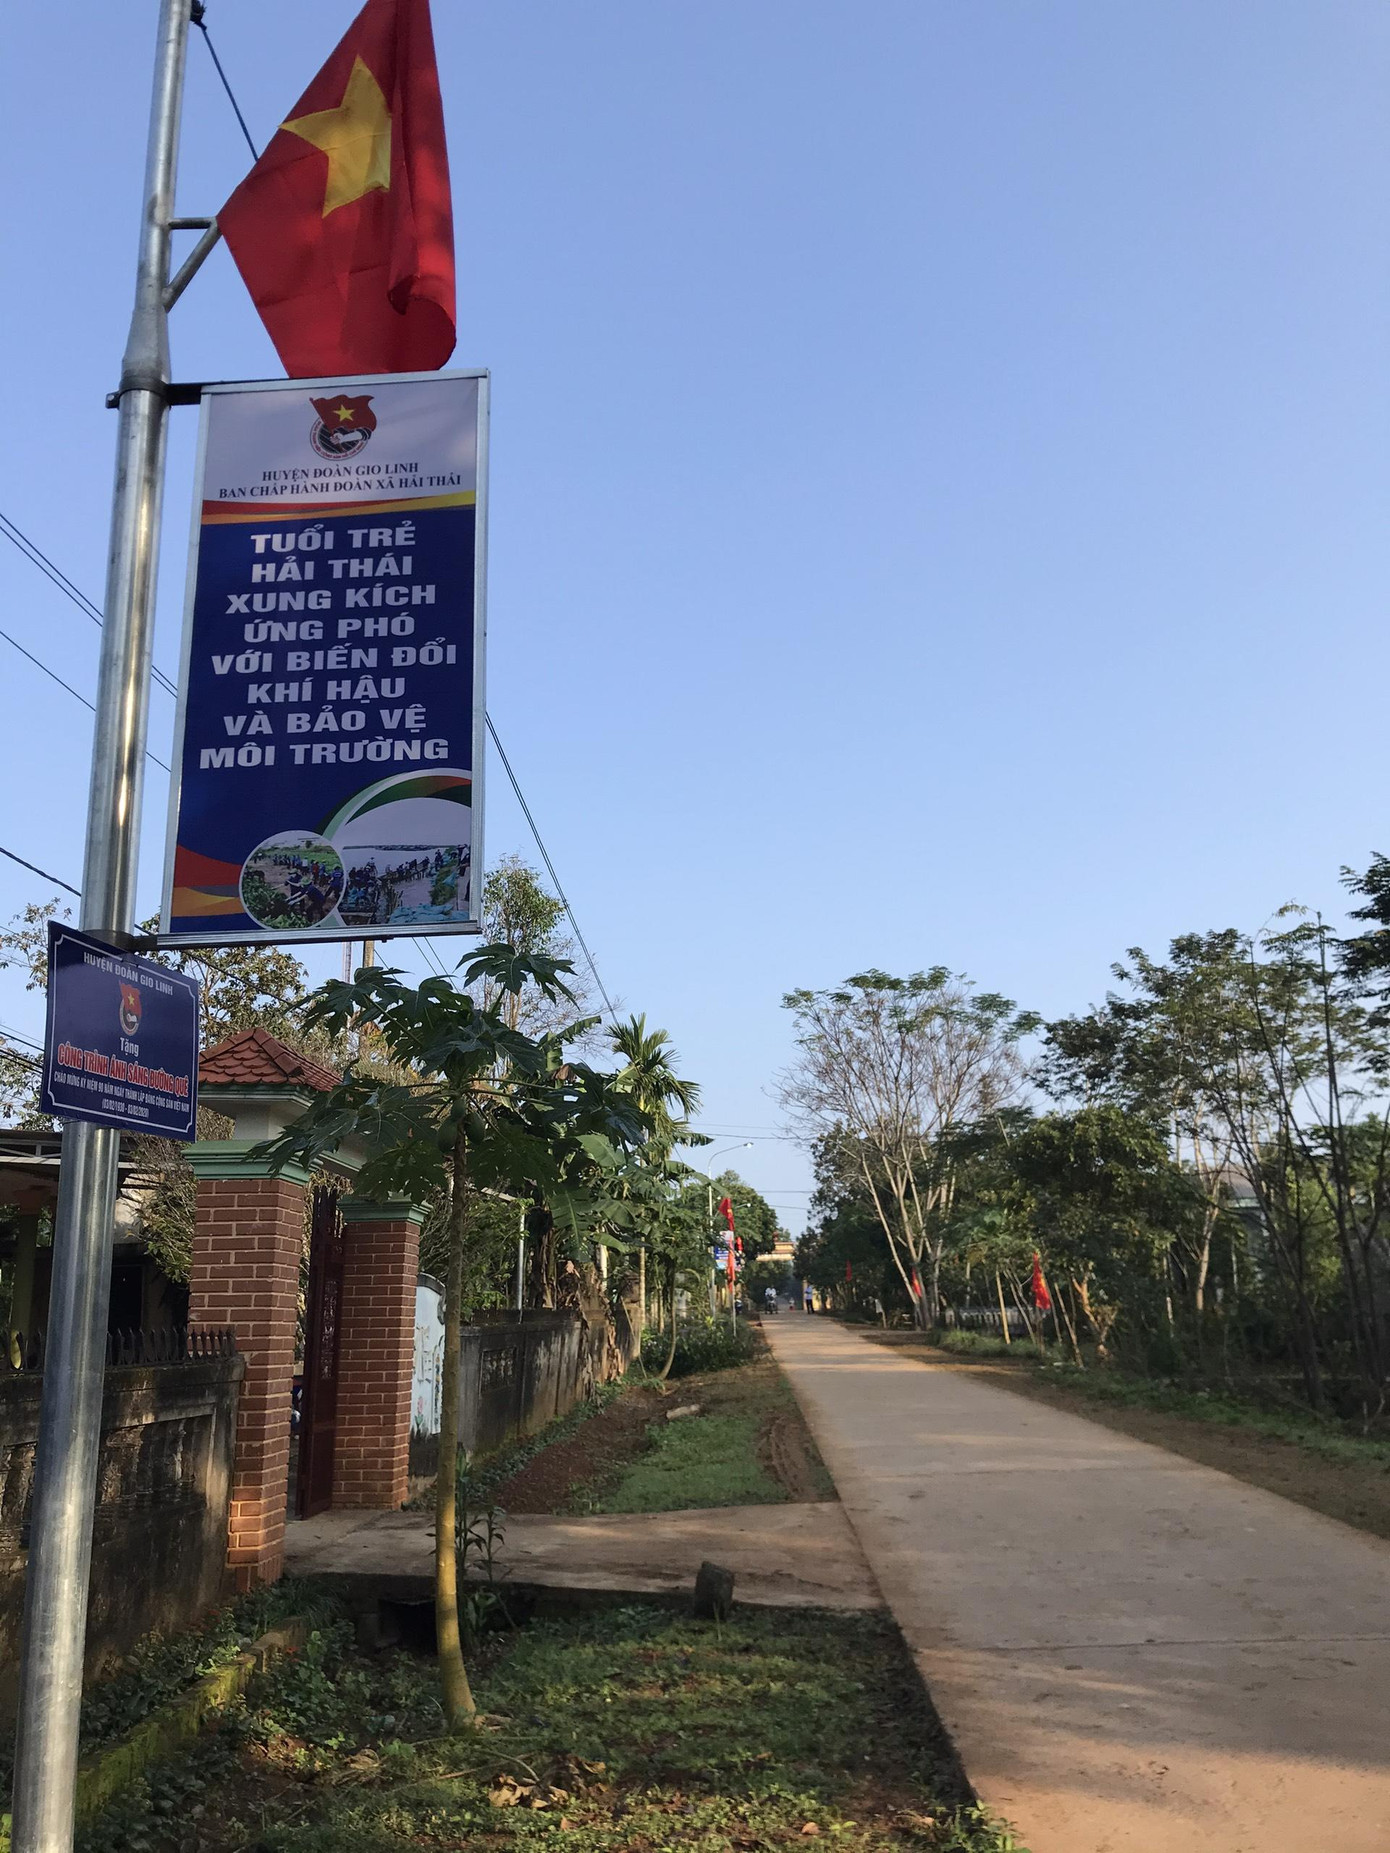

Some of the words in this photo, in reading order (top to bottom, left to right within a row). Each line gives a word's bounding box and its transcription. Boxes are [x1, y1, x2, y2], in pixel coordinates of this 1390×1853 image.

[219, 487, 248, 498] BAN
[290, 481, 330, 494] HÀNH
[333, 477, 372, 492] ĐOÀN
[375, 475, 395, 490] XÃ
[398, 474, 424, 488] HẢI
[427, 471, 461, 486] THÁI
[262, 467, 310, 482] HUYỆN
[313, 464, 352, 478] ĐOÀN
[355, 464, 382, 476] GIO
[385, 462, 419, 474] LINH
[250, 523, 335, 553] TUỔI
[347, 520, 416, 549] TRẺ
[251, 555, 315, 583] HẢI
[328, 552, 412, 579] THÁI
[225, 589, 332, 615] XUNG
[345, 583, 436, 609] KÍCH
[243, 618, 324, 643] ỨNG
[337, 612, 415, 639] PHÓ
[211, 649, 273, 675] VỚI
[286, 643, 378, 672] BIẾN
[391, 636, 457, 667] ĐỔI
[247, 677, 314, 704] KHÍ
[326, 674, 406, 704] HẬU
[223, 710, 273, 736] VÀ
[286, 704, 366, 733] BẢO
[379, 703, 427, 733] VỆ
[199, 742, 276, 770] MÔI
[289, 736, 449, 765] TRƯỜNG
[83, 951, 113, 973] HUYỆN
[115, 964, 138, 982] ĐOÀN
[140, 974, 154, 988] GIO
[155, 980, 173, 996] LINH
[119, 1037, 139, 1057] Tặng
[57, 1040, 83, 1070] CÔNG
[83, 1048, 109, 1077] TRÌNH
[109, 1054, 128, 1082] ÁNH
[127, 1060, 149, 1086] SÁNG
[149, 1067, 174, 1094] ĐƯỜNG
